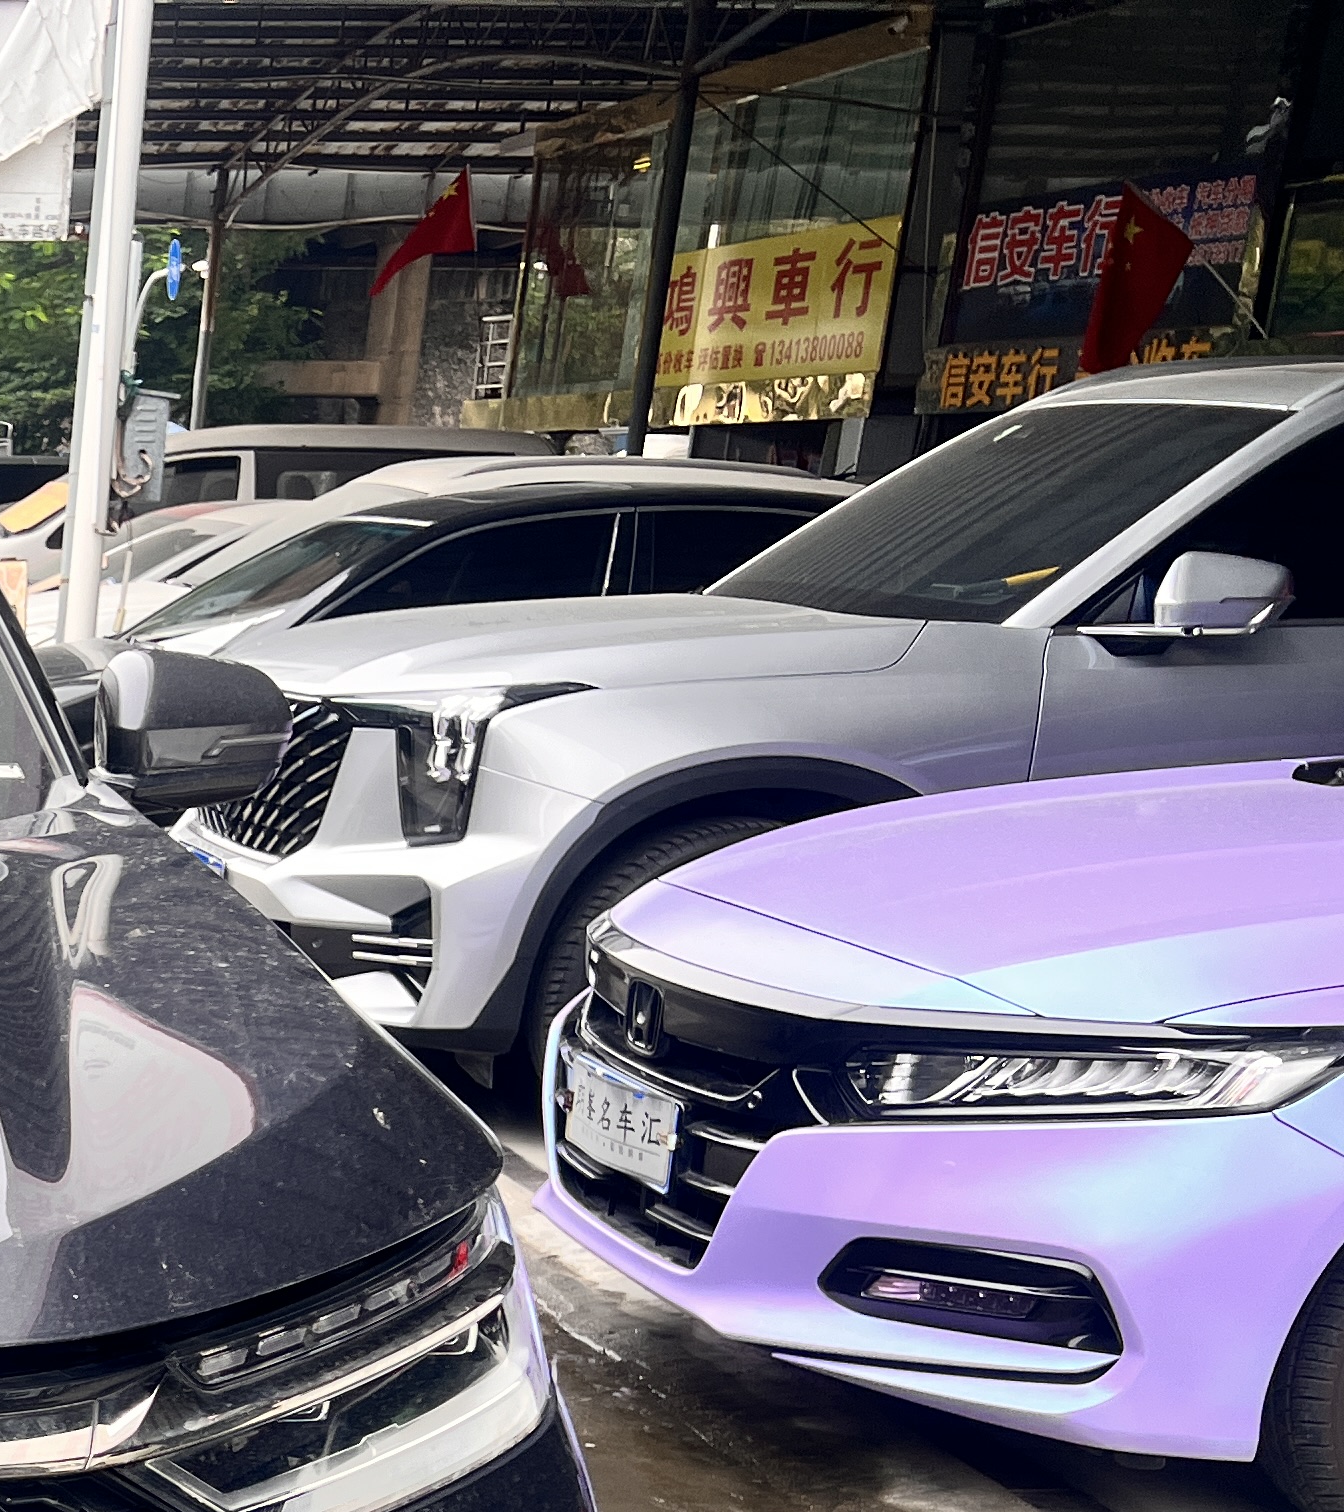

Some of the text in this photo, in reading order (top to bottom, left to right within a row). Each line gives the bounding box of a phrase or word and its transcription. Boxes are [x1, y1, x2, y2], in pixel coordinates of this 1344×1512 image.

[962, 194, 1124, 290] 信安车行
[656, 349, 694, 376] 价收车
[769, 331, 864, 367] 13413800088
[940, 347, 1061, 410] 信安车行
